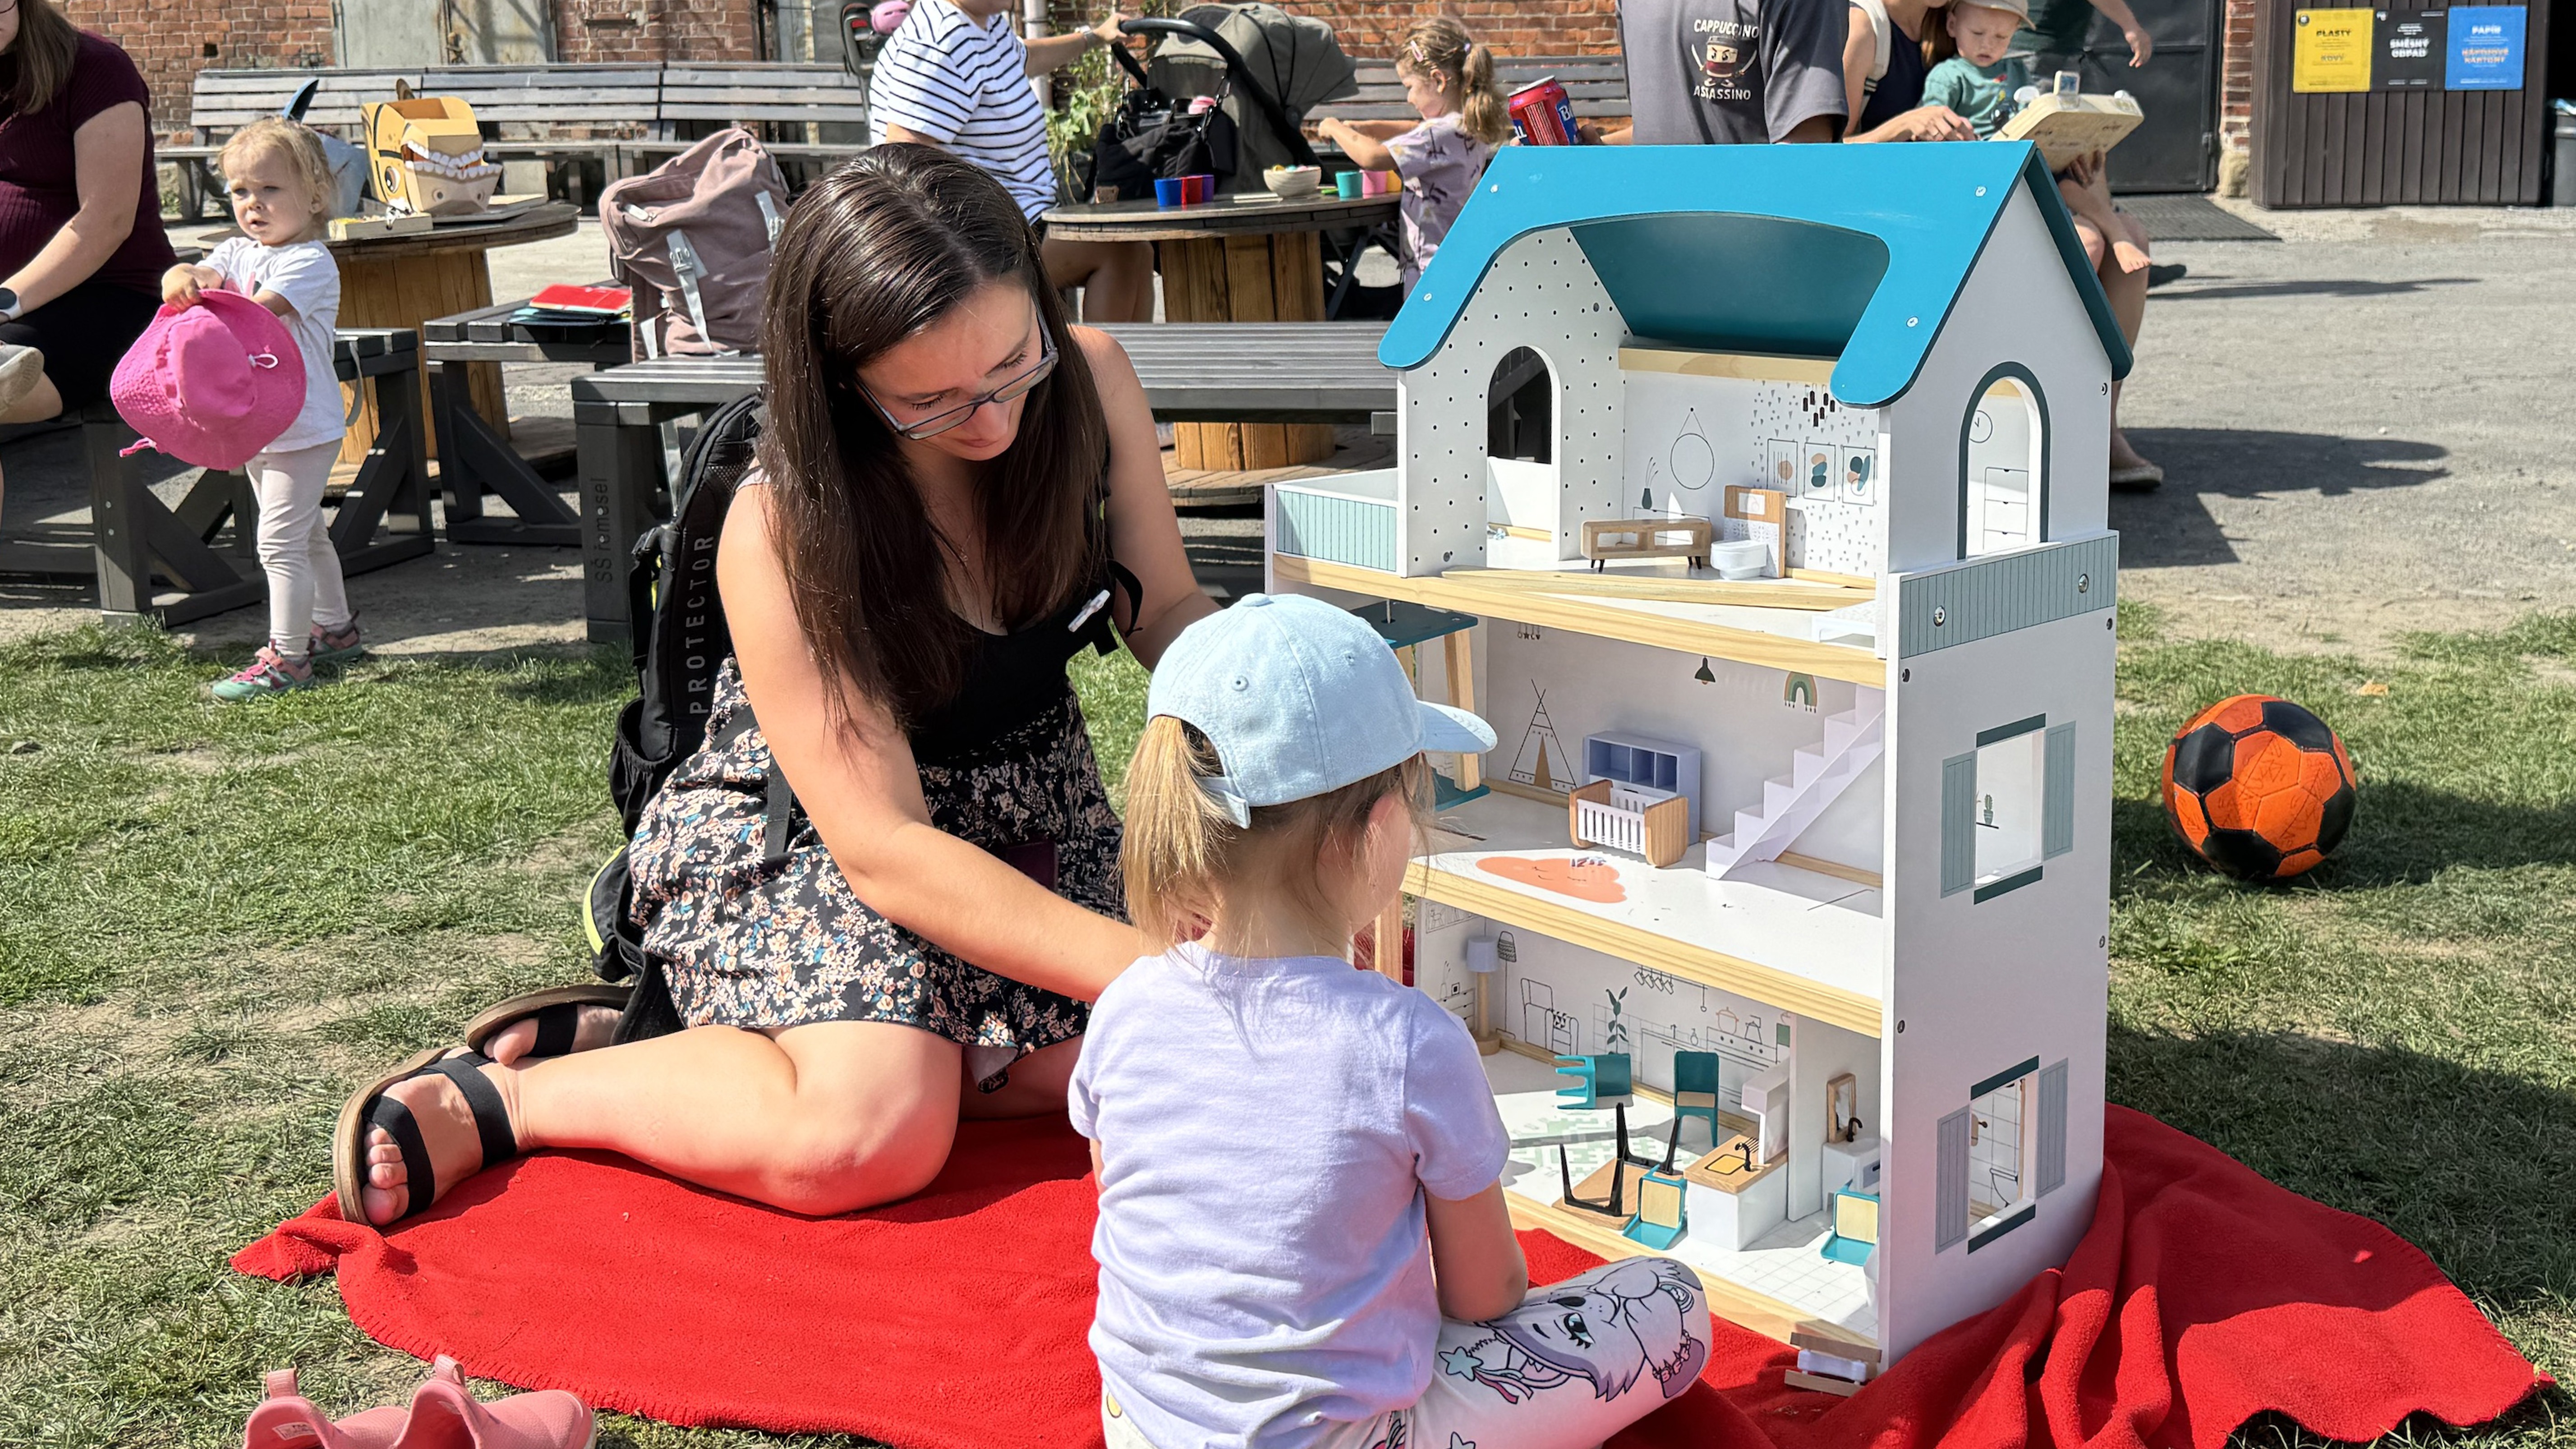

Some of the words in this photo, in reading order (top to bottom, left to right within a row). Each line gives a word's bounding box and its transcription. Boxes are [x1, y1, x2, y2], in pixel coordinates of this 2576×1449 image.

[1694, 19, 1759, 38] CAPPUCCINO
[2392, 48, 2428, 58] ODPAD
[685, 535, 714, 714] PROTECTOR
